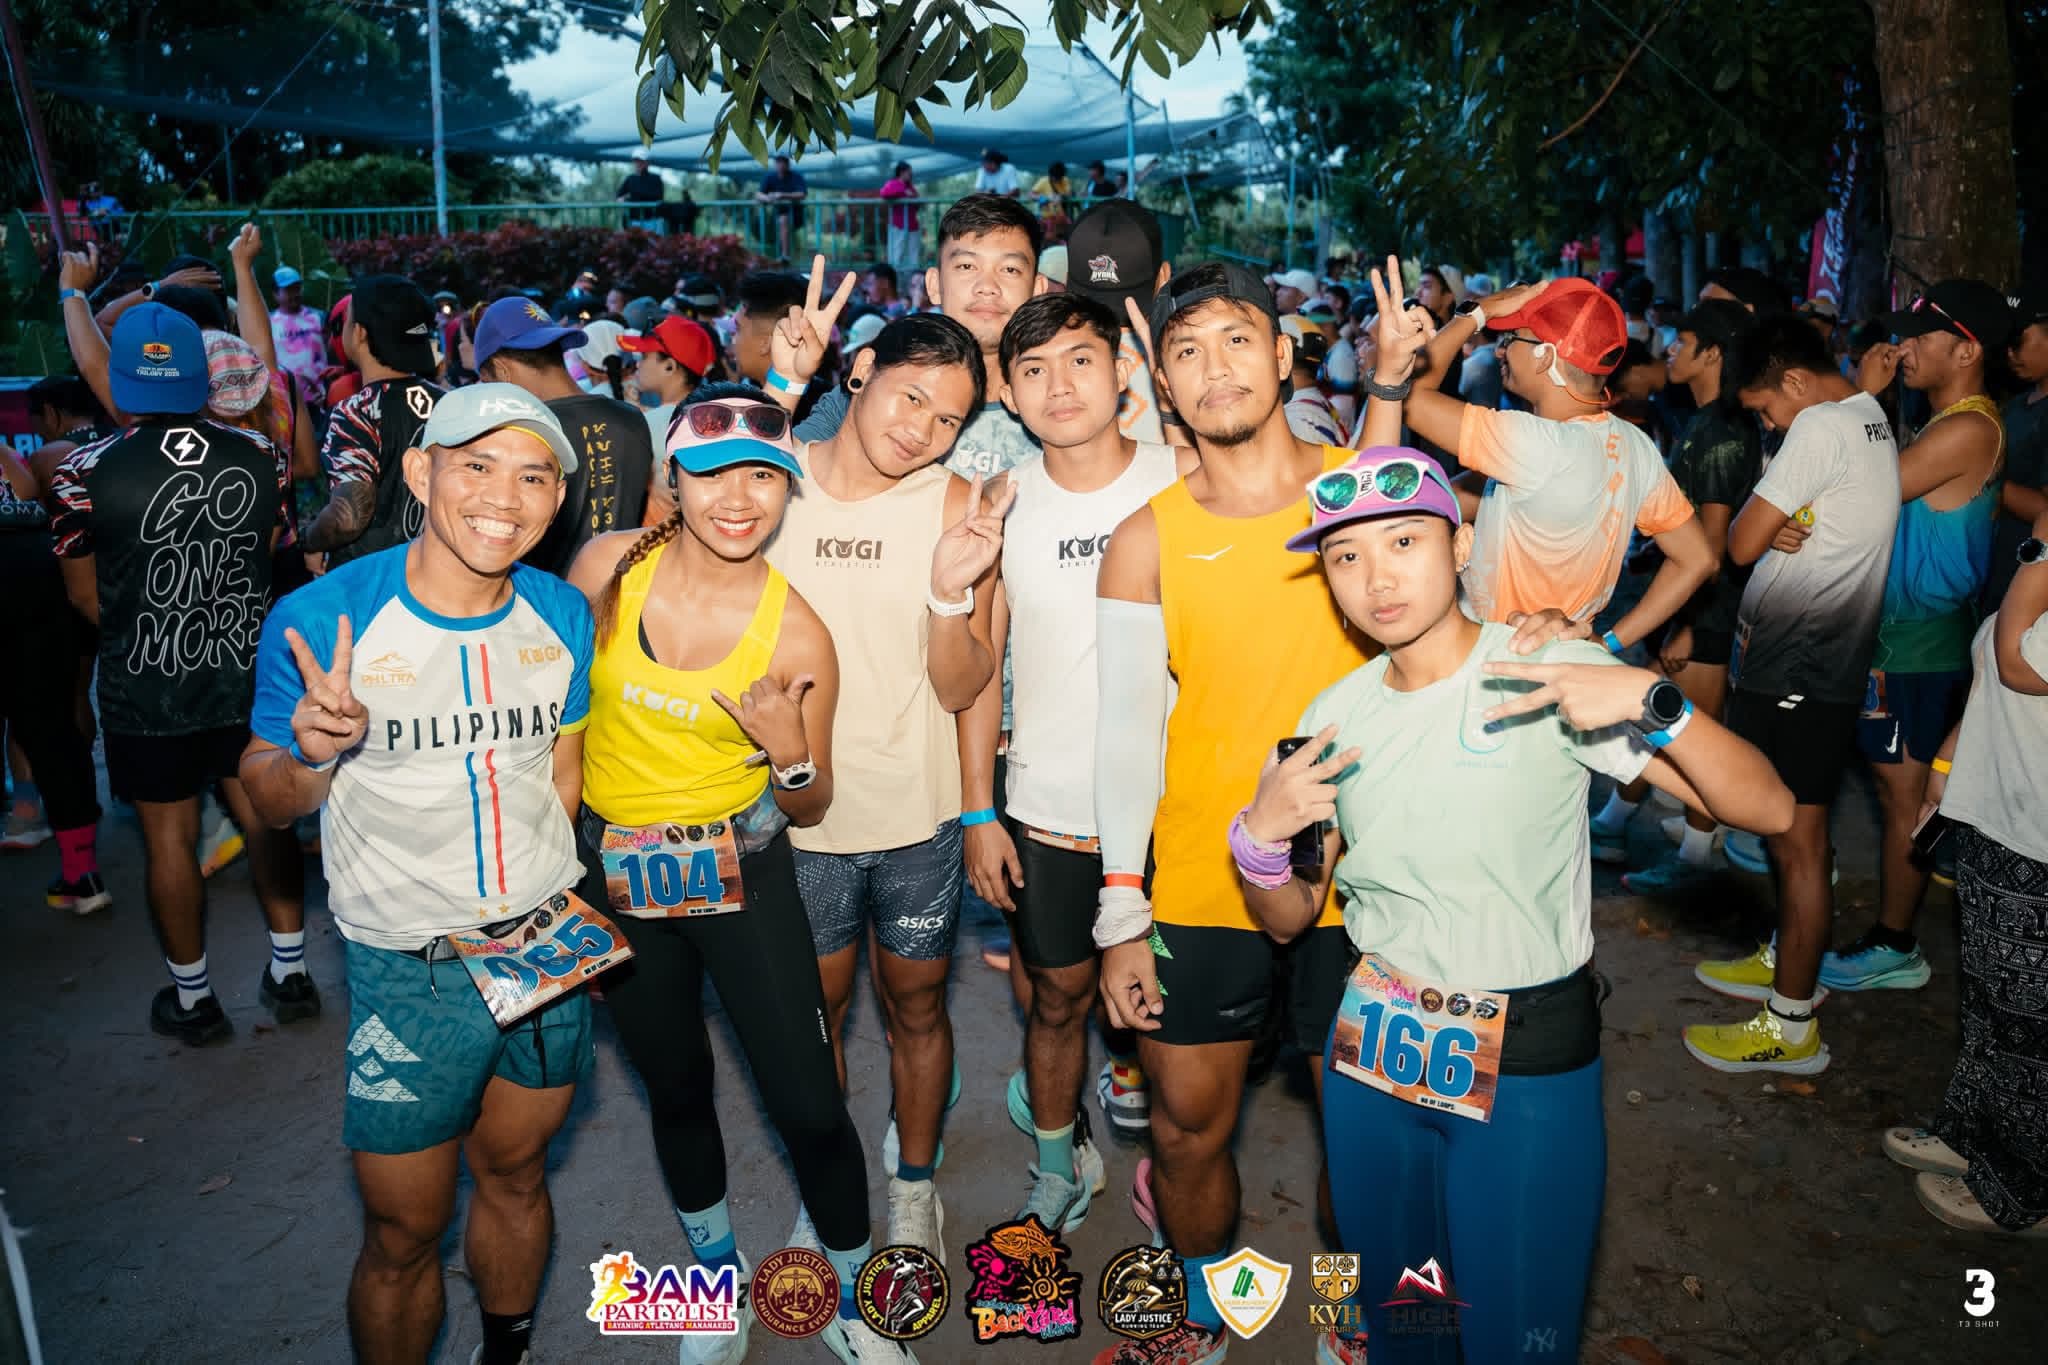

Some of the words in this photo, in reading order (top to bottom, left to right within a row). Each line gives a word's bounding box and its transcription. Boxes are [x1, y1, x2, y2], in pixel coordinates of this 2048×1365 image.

[140, 467, 257, 547] GO
[146, 532, 258, 608] ONE
[128, 594, 262, 677] MORE
[386, 702, 559, 751] PILIPINAS
[618, 847, 725, 909] 104
[897, 914, 945, 929] asics
[1358, 1001, 1478, 1099] 166
